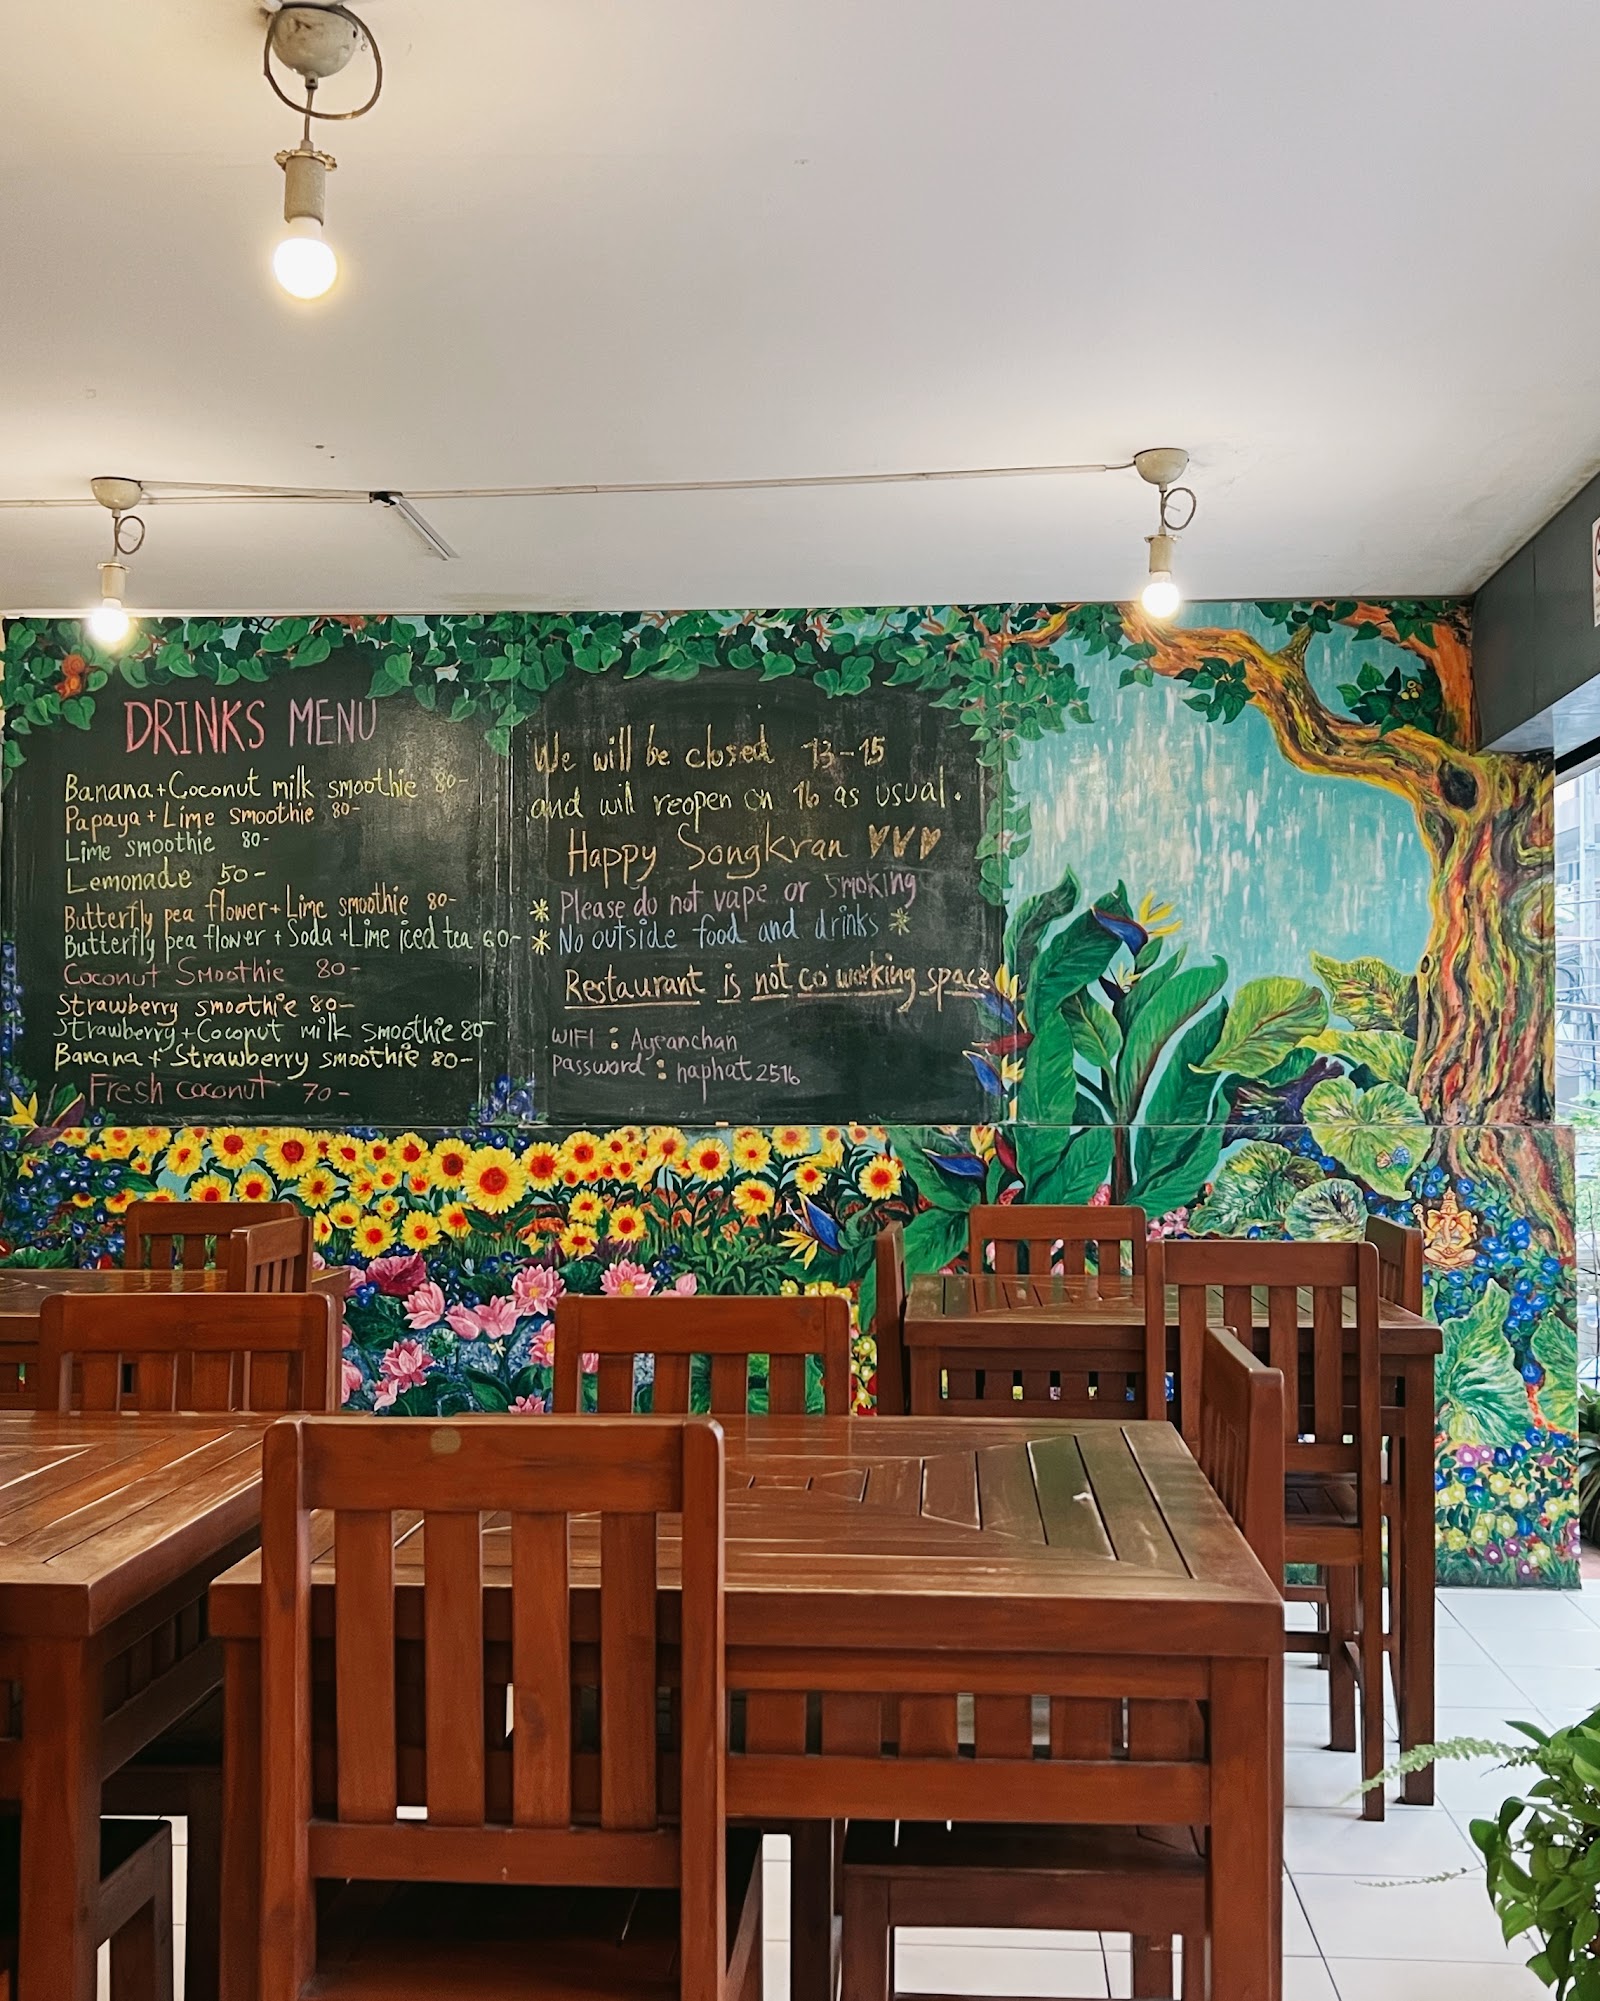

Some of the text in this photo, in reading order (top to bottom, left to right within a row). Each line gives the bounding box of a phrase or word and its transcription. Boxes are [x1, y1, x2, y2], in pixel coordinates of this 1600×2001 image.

[124, 697, 377, 755] DRINKS MENU
[534, 731, 577, 773] We
[593, 724, 632, 772] will
[646, 723, 671, 767] be
[685, 723, 775, 770] closed
[272, 765, 315, 800] milk
[328, 768, 419, 799] smoothie
[229, 802, 314, 825] smoothie
[332, 802, 361, 818] 80-
[530, 786, 584, 819] and
[600, 780, 636, 816] will
[653, 789, 732, 833] reopen
[744, 788, 773, 811] on
[793, 780, 820, 810] 16
[834, 785, 860, 809] as
[65, 829, 270, 864] Lime smoothie 80-
[567, 828, 657, 889] Happy
[66, 856, 193, 894] Lemonade
[64, 899, 153, 938] Butterfly
[164, 907, 195, 938] pea
[338, 882, 409, 916] smoothie
[427, 892, 457, 910] 80-
[560, 889, 626, 924] Please
[633, 886, 658, 919] do
[670, 879, 704, 915] not
[714, 883, 767, 922] vape
[784, 881, 810, 903] or
[64, 927, 155, 965] Butterfly
[165, 934, 197, 965] pea
[203, 924, 266, 953] flower
[287, 917, 333, 948] Soda
[400, 915, 439, 954] iced
[442, 915, 473, 950] tea
[559, 903, 879, 955] No outside food and drinks
[64, 962, 160, 988] Coconut
[316, 958, 361, 979] 80-
[565, 964, 706, 1003] Restaurant
[724, 962, 742, 999] is
[755, 952, 794, 994] not
[928, 967, 991, 1012] space
[56, 992, 355, 1027] Strawberry smoothie 80-
[300, 1012, 352, 1042] milk
[361, 1014, 456, 1045] smoothie
[54, 1042, 144, 1072] Banana
[170, 1043, 309, 1080] Strawberry
[319, 1042, 420, 1069] smoothie
[431, 1052, 473, 1070] 80-
[90, 1069, 350, 1106] Fresh coconut 70-
